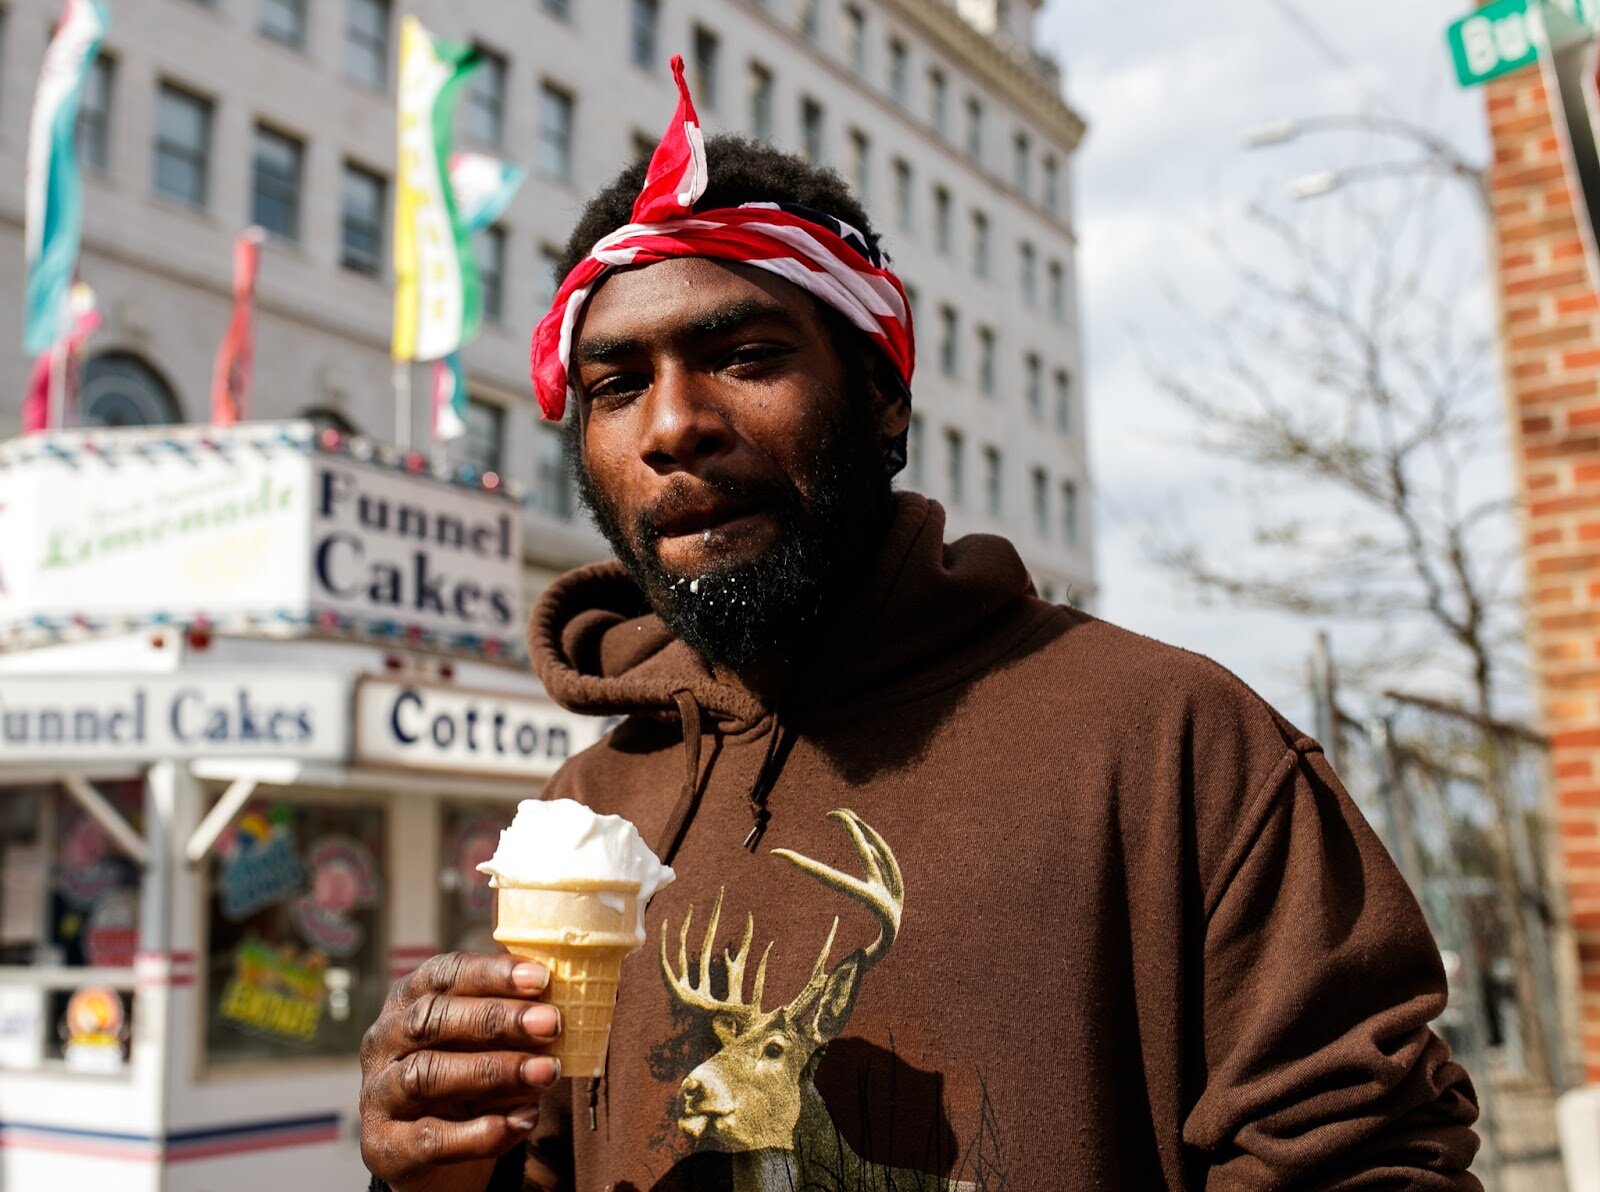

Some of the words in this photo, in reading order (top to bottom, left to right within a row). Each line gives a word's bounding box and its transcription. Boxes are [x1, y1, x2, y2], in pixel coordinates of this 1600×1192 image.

[319, 470, 511, 560] Funnel
[314, 532, 513, 626] Cakes
[0, 688, 146, 743] unnel
[169, 687, 313, 743] Cakes
[390, 688, 570, 758] Cotton
